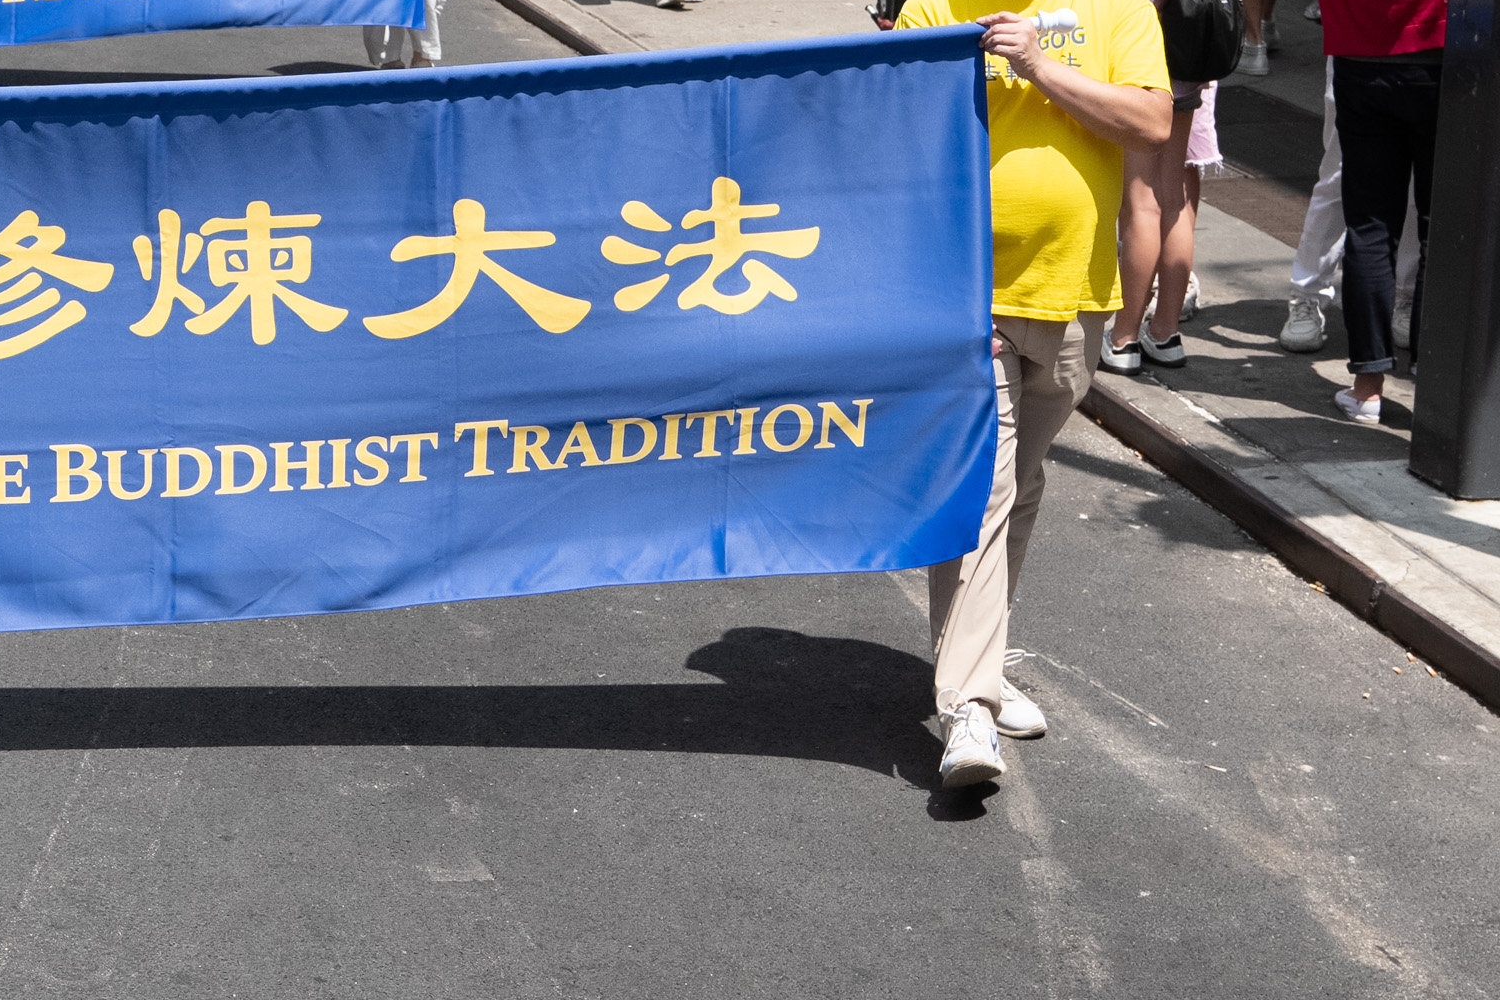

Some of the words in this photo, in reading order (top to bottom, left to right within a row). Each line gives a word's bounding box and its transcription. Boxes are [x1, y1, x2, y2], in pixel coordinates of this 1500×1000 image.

[1038, 27, 1086, 51] GOG
[49, 430, 440, 504] BUDDHIST
[455, 398, 874, 477] TRADITION
